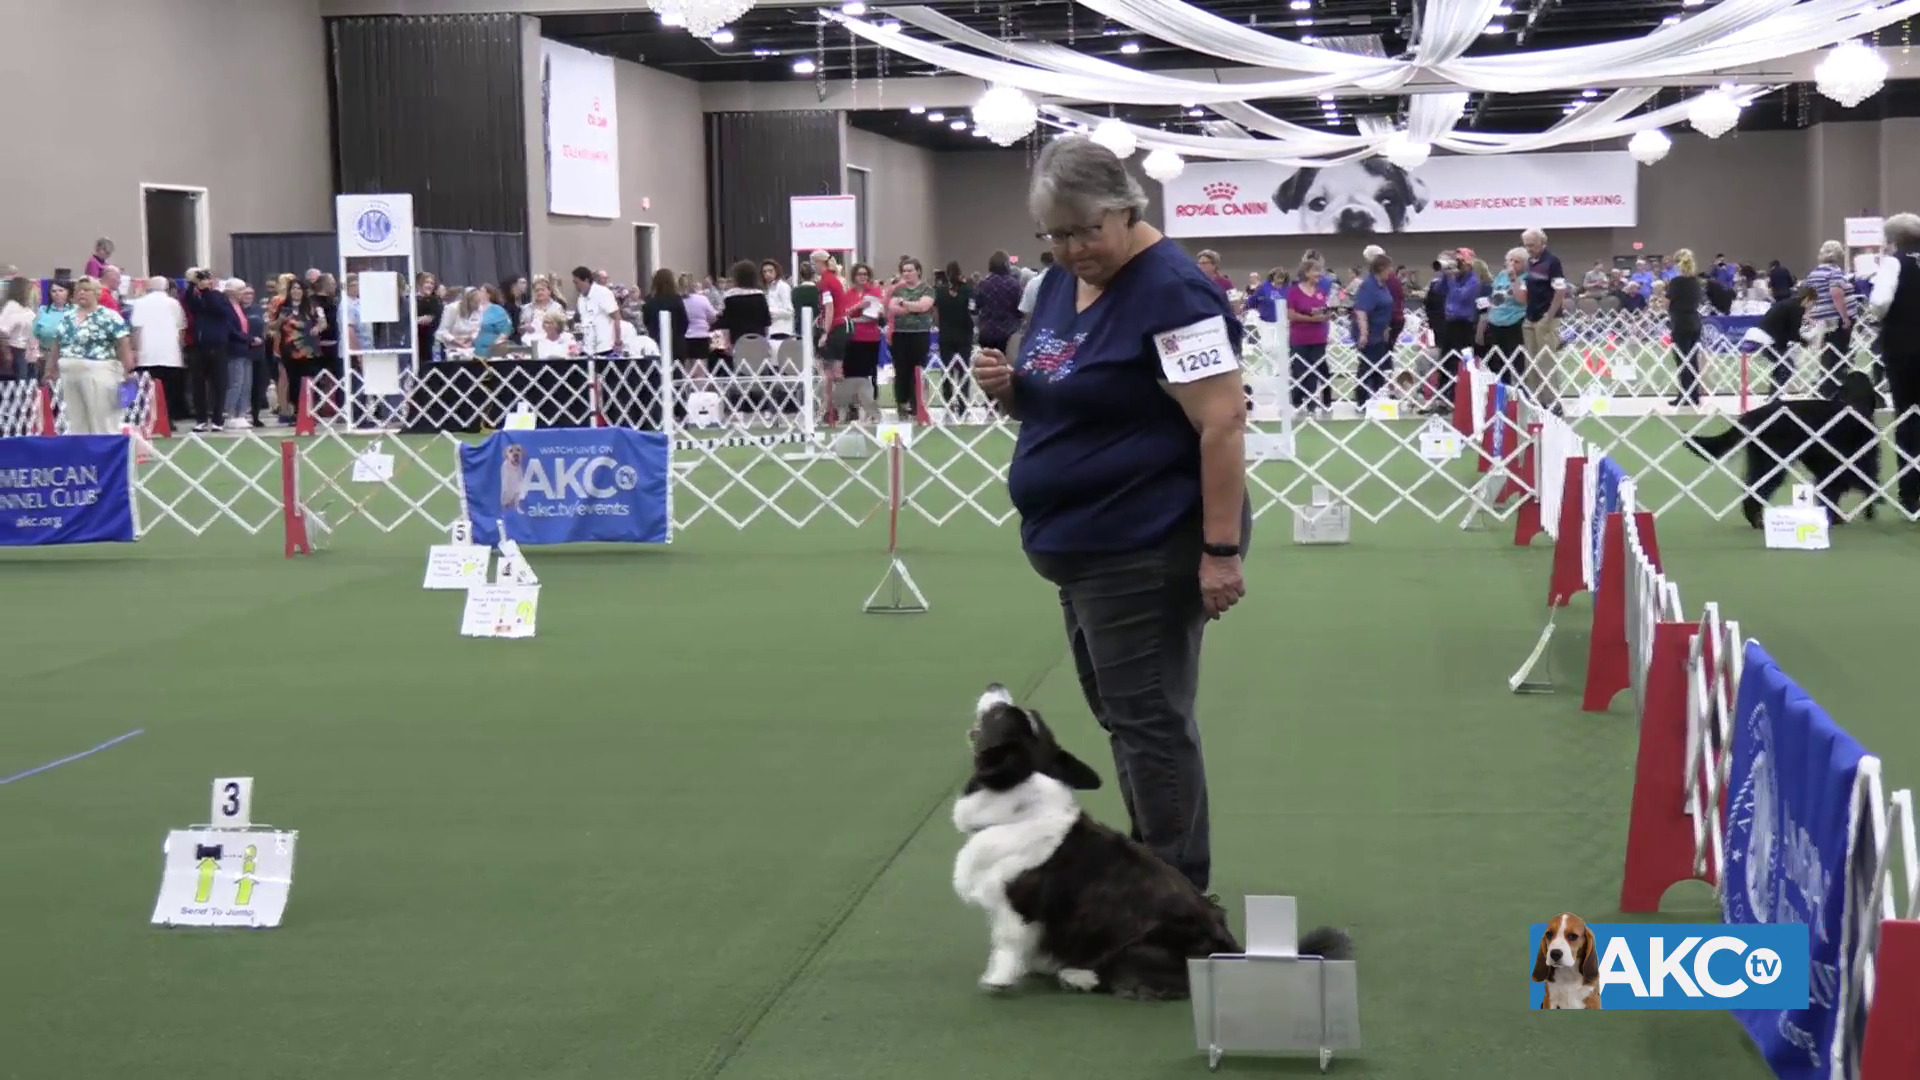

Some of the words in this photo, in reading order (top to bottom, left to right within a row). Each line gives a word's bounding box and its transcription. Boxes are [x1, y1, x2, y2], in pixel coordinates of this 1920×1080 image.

[1176, 203, 1219, 217] ROYAL
[1222, 202, 1268, 216] CANIN
[1434, 197, 1526, 210] MAGNIFICENCE
[1529, 197, 1543, 208] IN
[1546, 196, 1570, 207] THE
[1573, 194, 1625, 206] MAKING.
[1176, 348, 1222, 373] 1202
[538, 446, 572, 455] WATCH
[575, 445, 597, 454] LIVE
[598, 445, 614, 454] ON
[520, 456, 618, 499] AKC
[1798, 490, 1807, 502] 4
[528, 501, 630, 518] akc.tv/events
[16, 516, 62, 529] akc.org
[456, 524, 466, 541] 5
[222, 782, 240, 816] 3
[180, 906, 208, 916] Send
[211, 907, 223, 916] To
